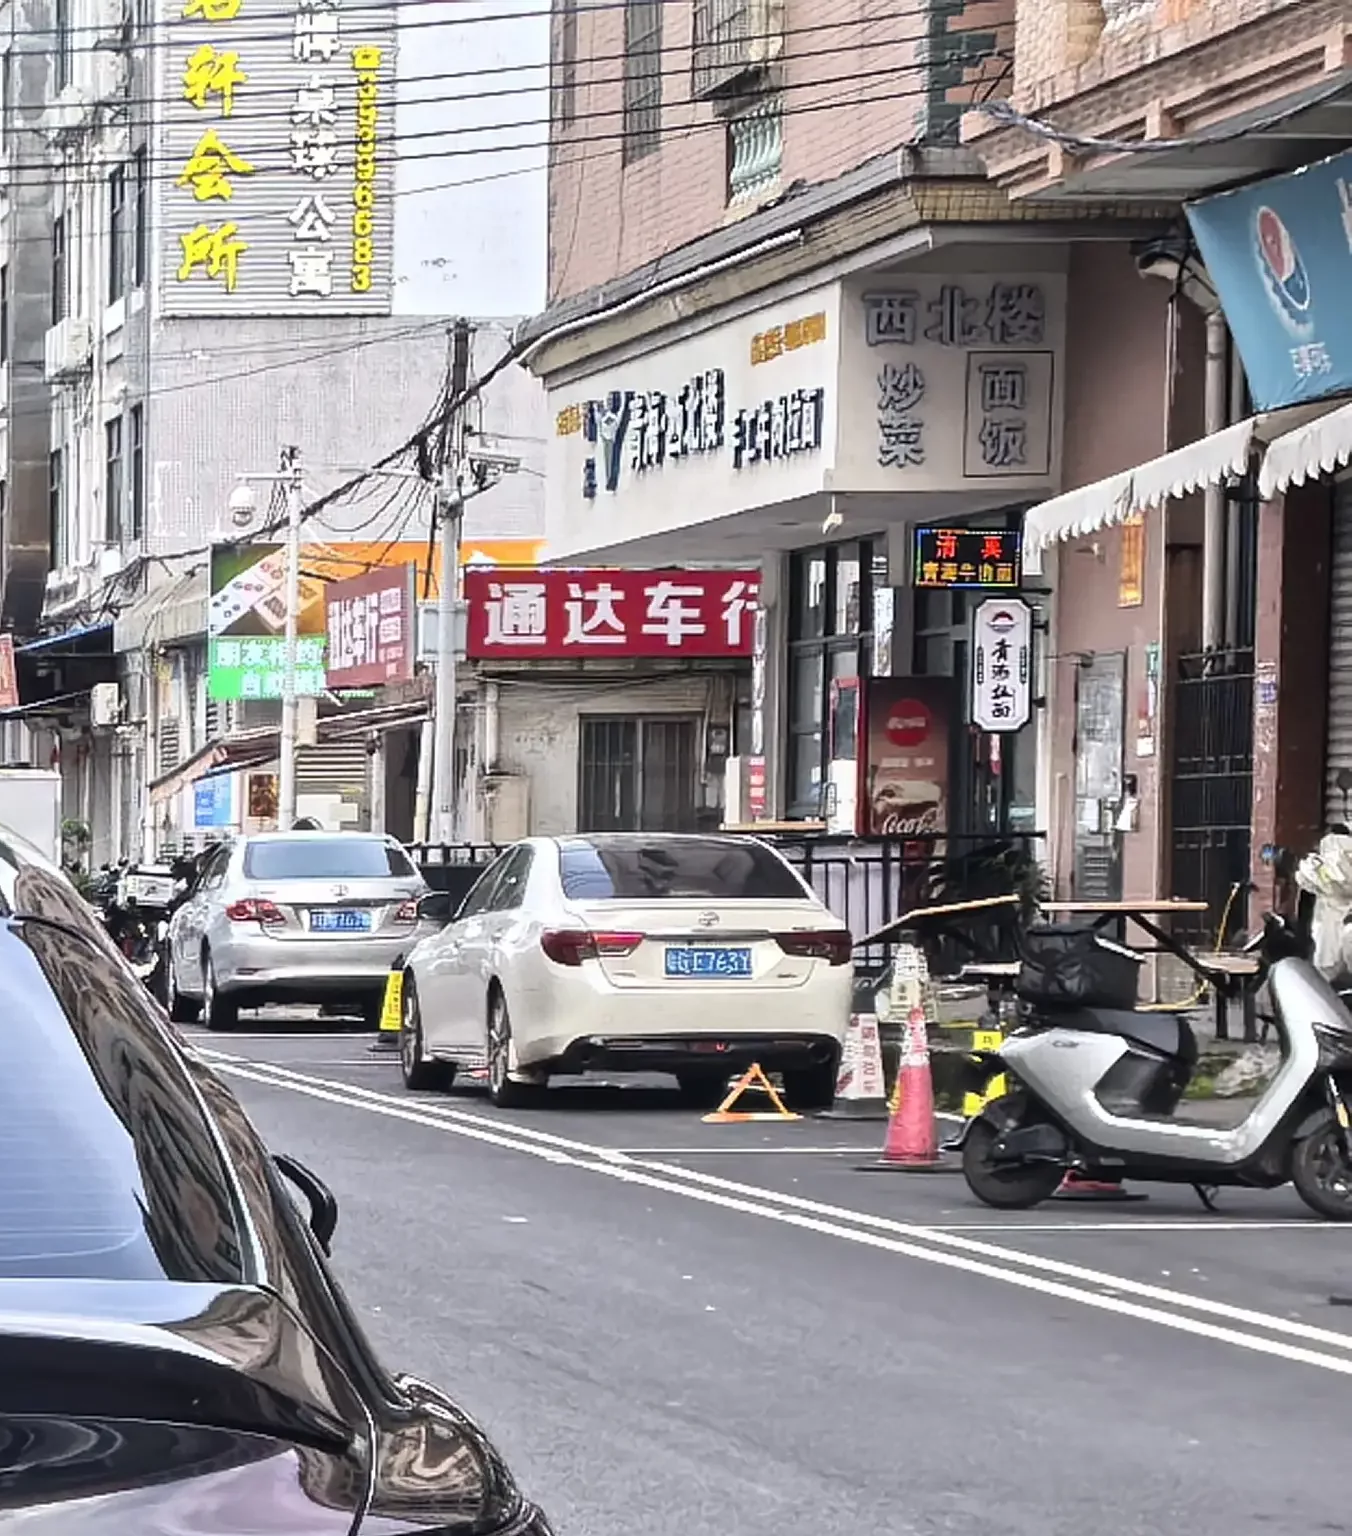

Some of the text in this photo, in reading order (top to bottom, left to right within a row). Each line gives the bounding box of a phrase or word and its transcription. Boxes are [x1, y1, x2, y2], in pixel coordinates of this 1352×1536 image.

[862, 283, 1045, 347] 西北楼
[875, 362, 927, 468] 炒菜
